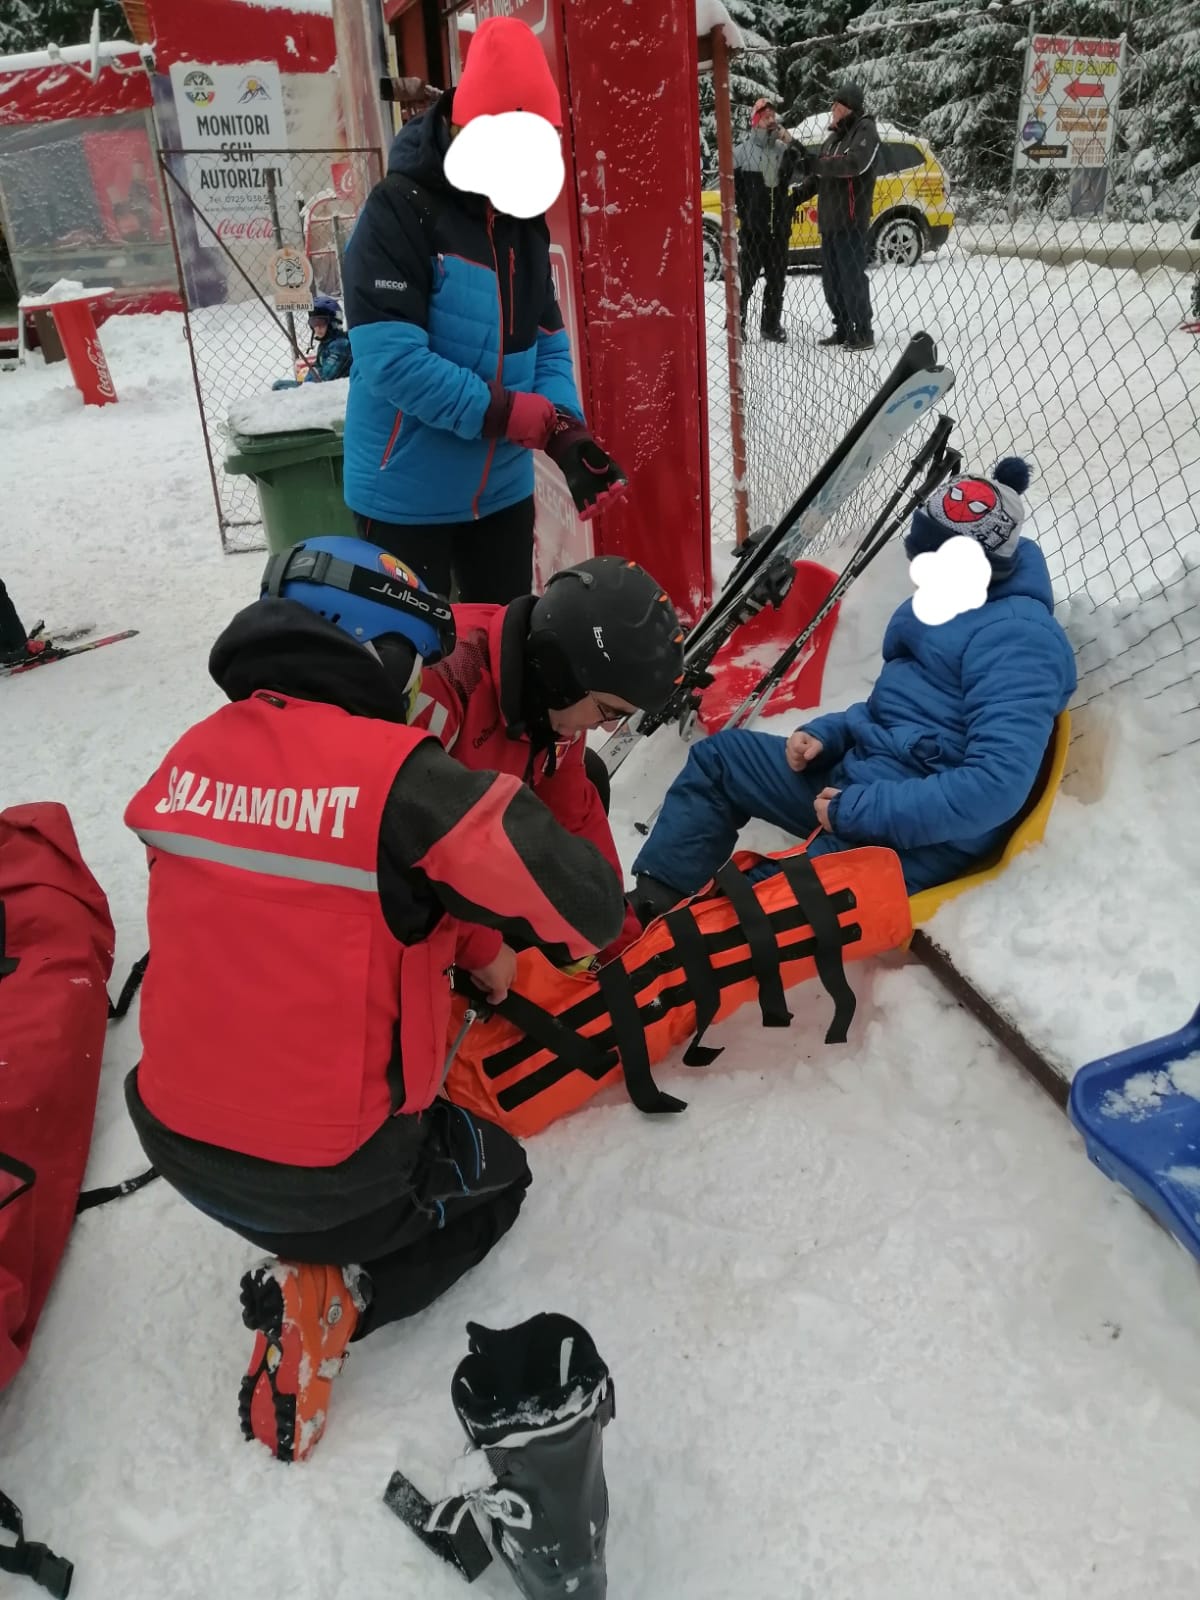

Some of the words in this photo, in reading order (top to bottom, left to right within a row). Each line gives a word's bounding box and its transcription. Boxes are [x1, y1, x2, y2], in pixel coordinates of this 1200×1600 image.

[196, 114, 270, 136] MONITORI
[220, 142, 254, 162] SCHI
[369, 582, 430, 612] Julbo
[155, 766, 360, 839] SALVAMONT
